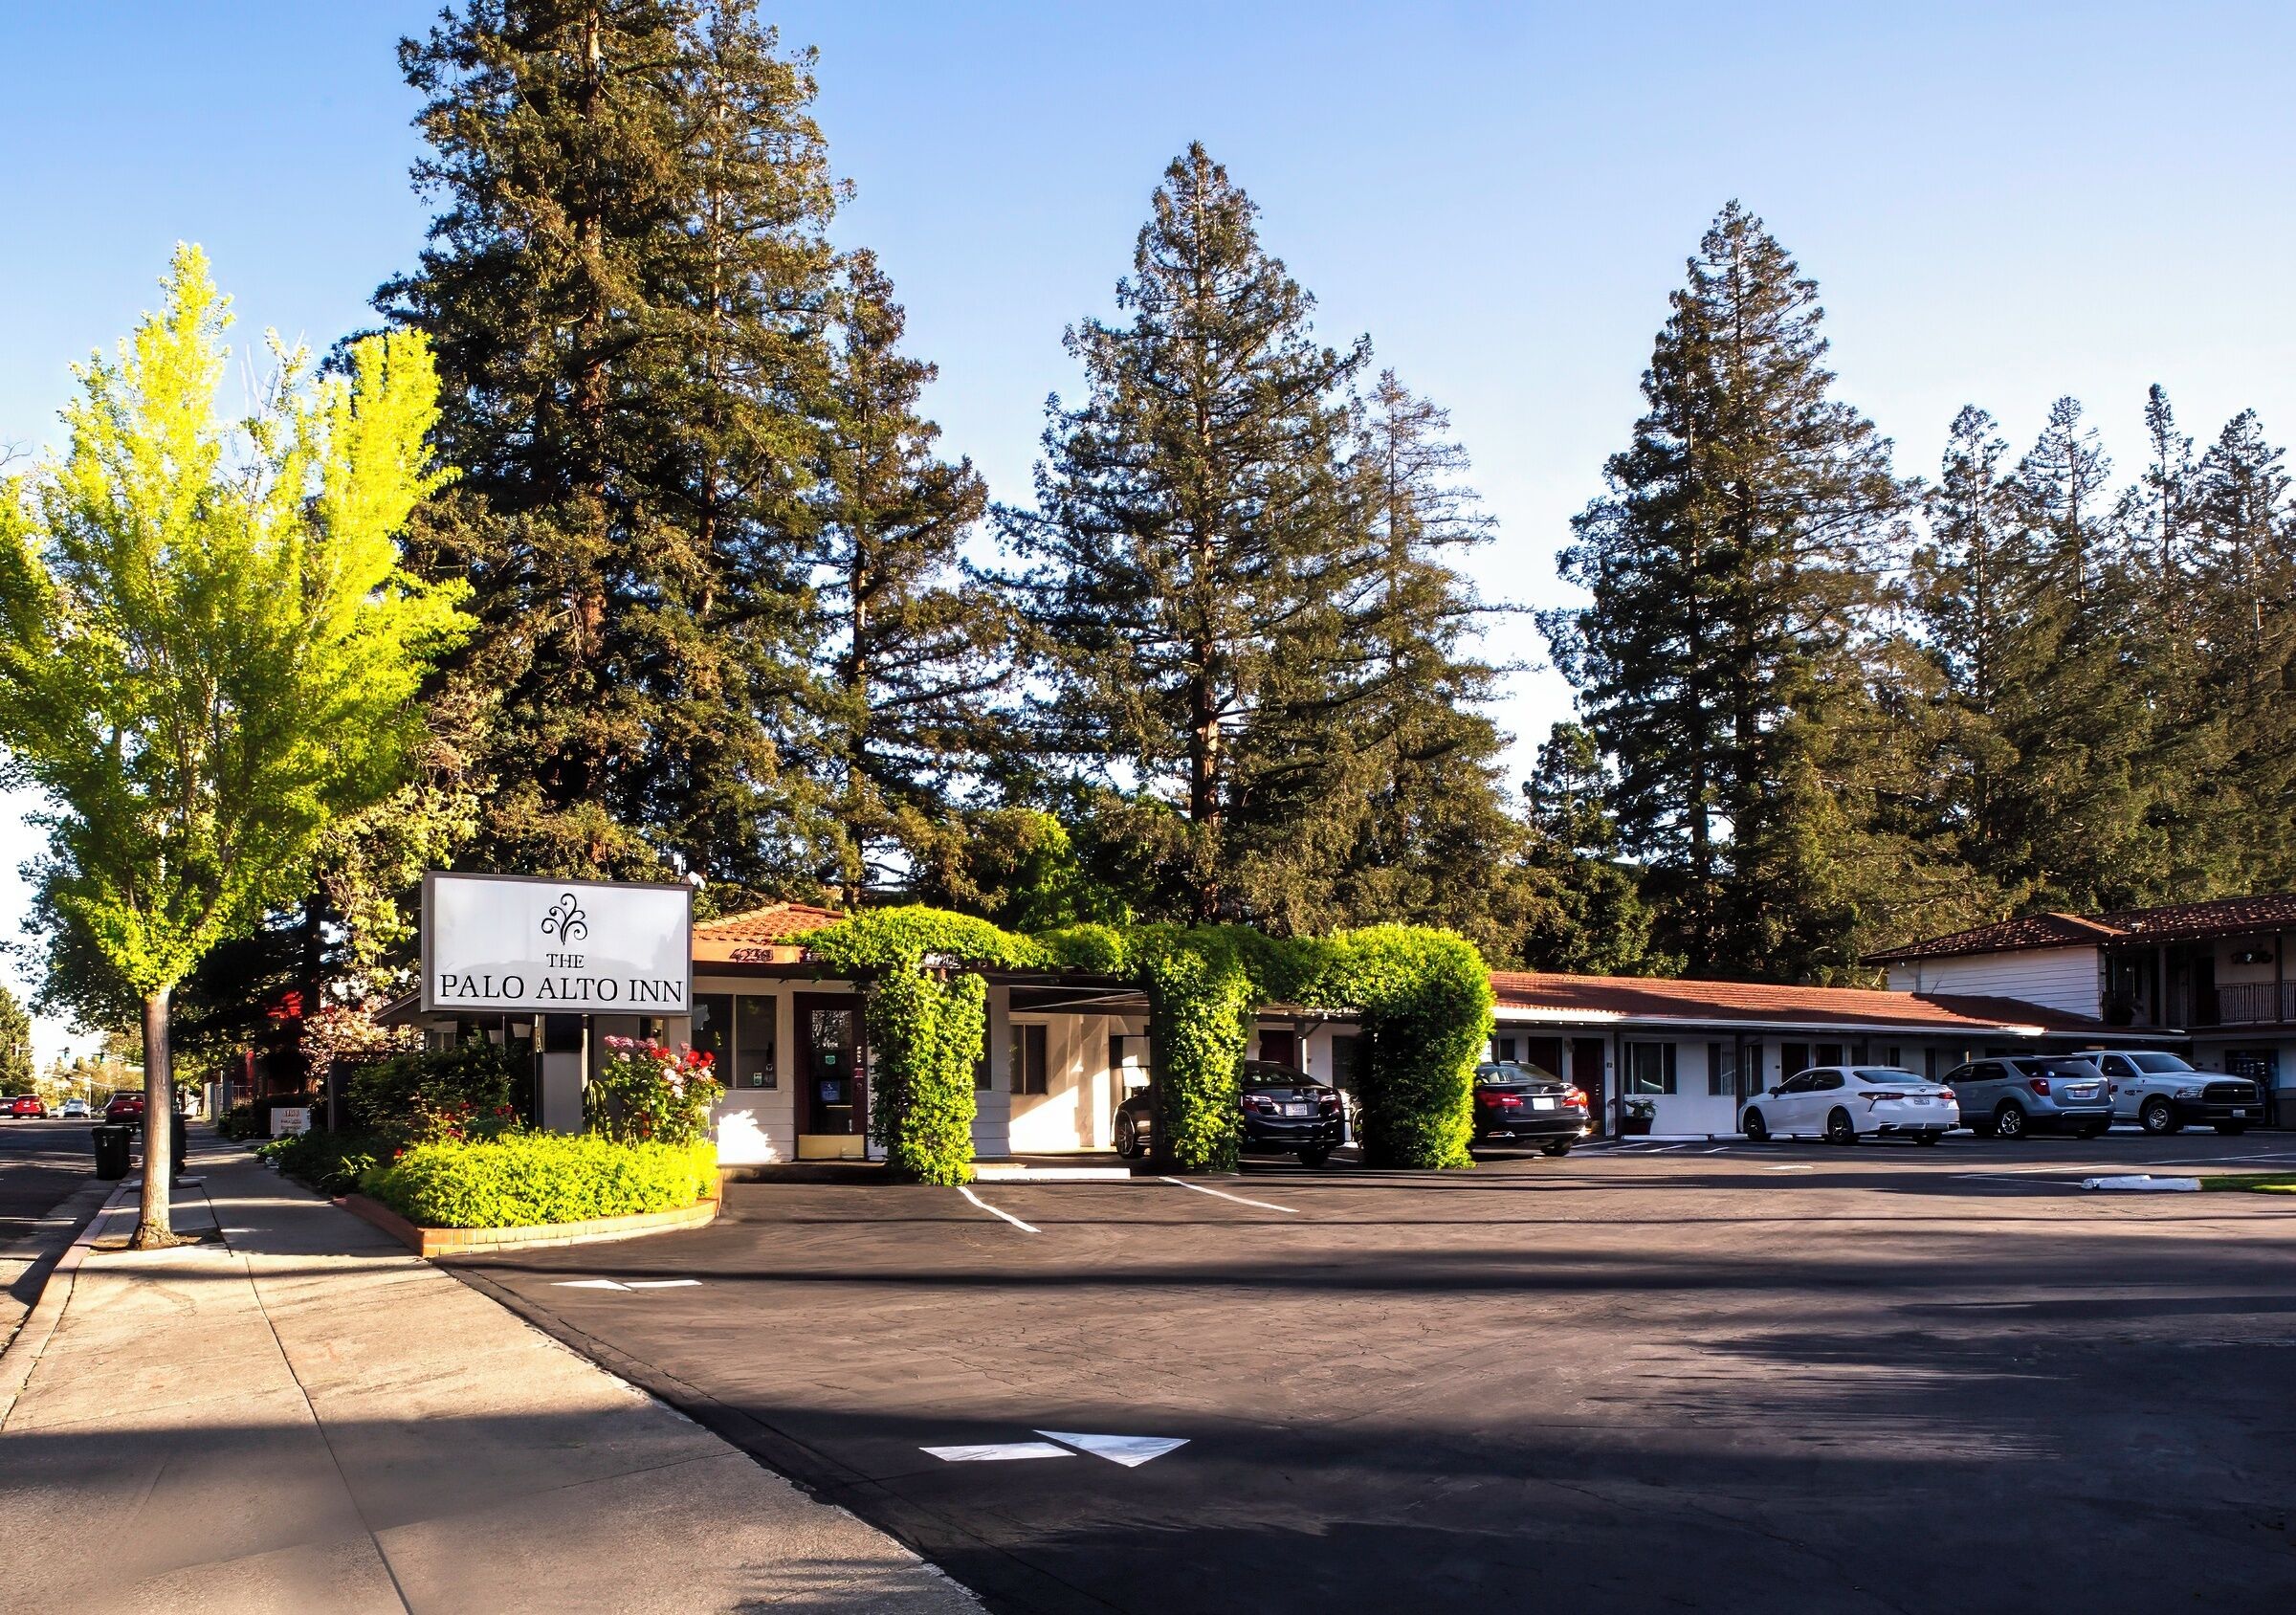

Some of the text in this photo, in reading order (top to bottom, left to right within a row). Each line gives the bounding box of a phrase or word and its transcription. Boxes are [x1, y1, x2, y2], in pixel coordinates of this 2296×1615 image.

[546, 953, 585, 969] THE
[440, 974, 684, 1003] PALO ALTO INN
